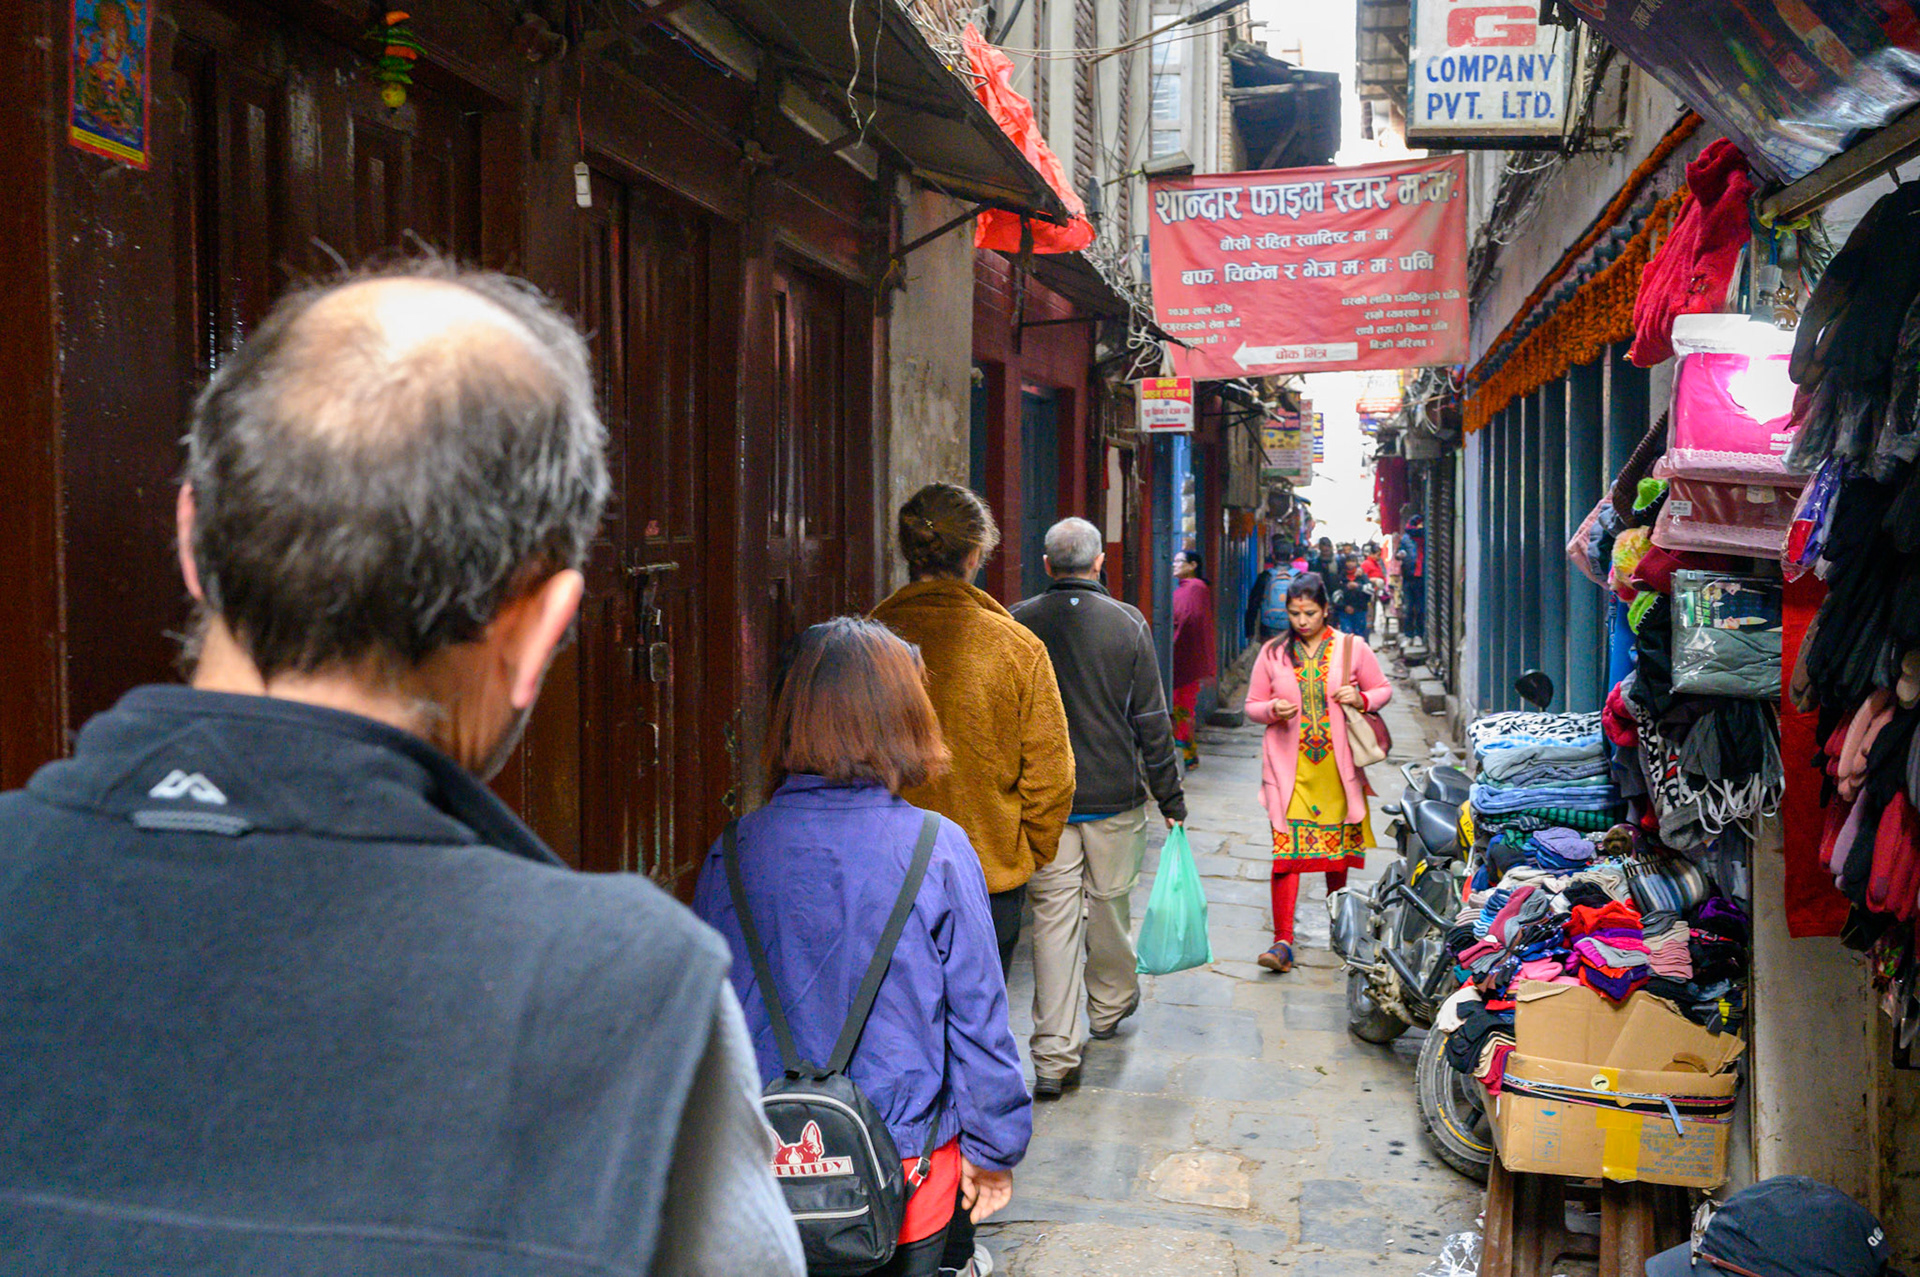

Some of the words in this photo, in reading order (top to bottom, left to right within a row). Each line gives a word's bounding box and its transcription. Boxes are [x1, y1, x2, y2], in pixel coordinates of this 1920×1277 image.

[1447, 6, 1537, 47] G
[1427, 54, 1556, 83] COMPANY
[1427, 92, 1483, 120] PVT.
[1502, 91, 1555, 119] LTD.
[1154, 187, 1243, 225] शान्दार
[1249, 180, 1325, 221] फाइभ
[1331, 175, 1391, 213] स्टार
[1219, 235, 1251, 251] बोसो
[1255, 232, 1291, 249] रहित
[1224, 262, 1279, 284] चिकेन
[1284, 264, 1297, 280] र
[1302, 258, 1337, 278] भेज
[1399, 251, 1435, 270] पनि
[1275, 347, 1300, 360] चोक
[1304, 346, 1328, 360] भित्र
[789, 1161, 844, 1176] PUPPY
